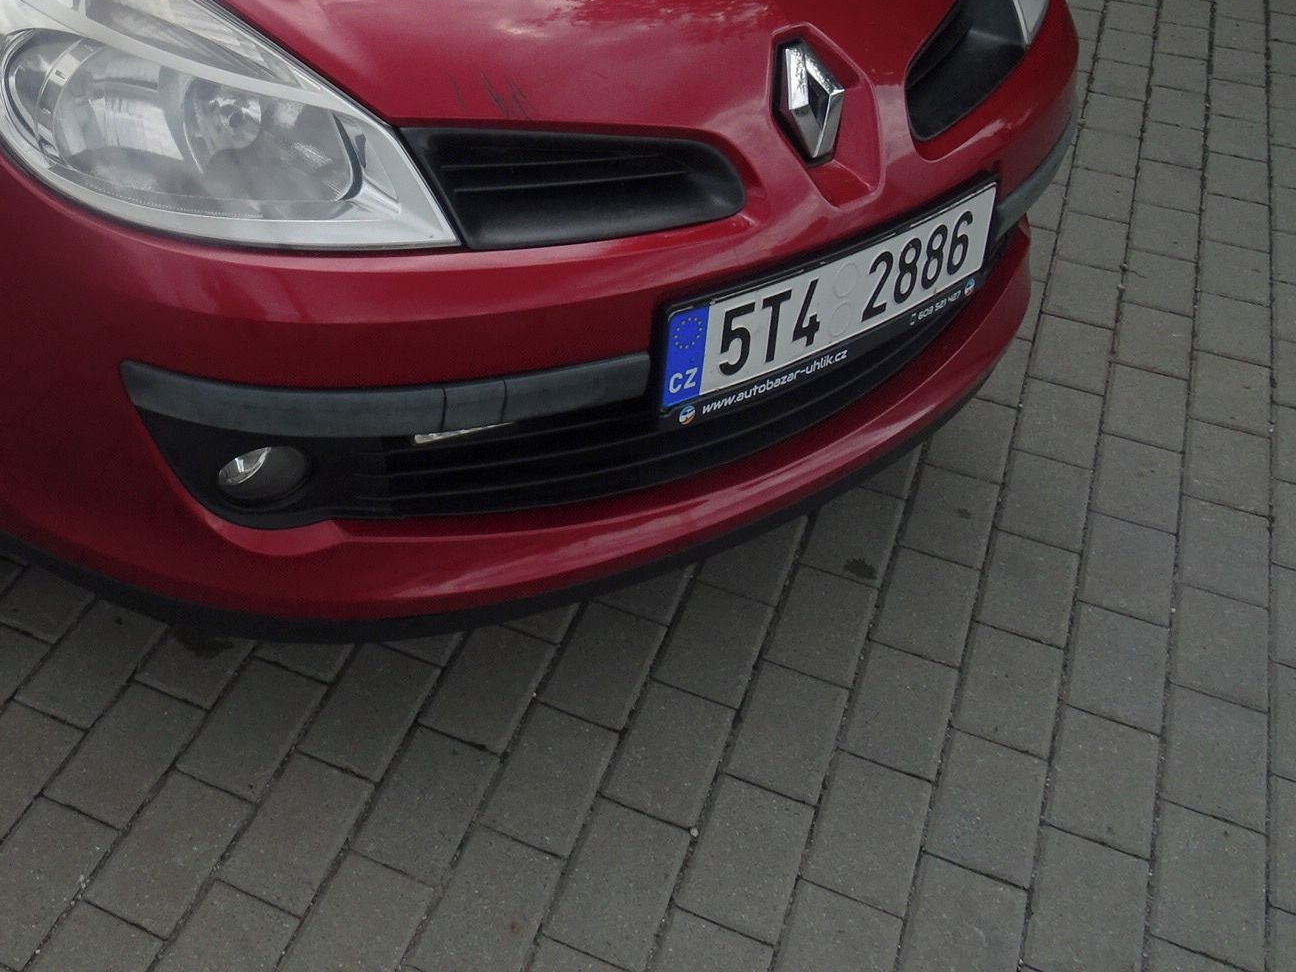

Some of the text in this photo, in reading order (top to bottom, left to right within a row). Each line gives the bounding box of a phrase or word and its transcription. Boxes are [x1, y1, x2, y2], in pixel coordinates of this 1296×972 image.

[719, 210, 974, 376] 5T4 2886
[669, 367, 698, 394] CZ
[702, 348, 849, 415] www.autobazar-uhlik.cz
